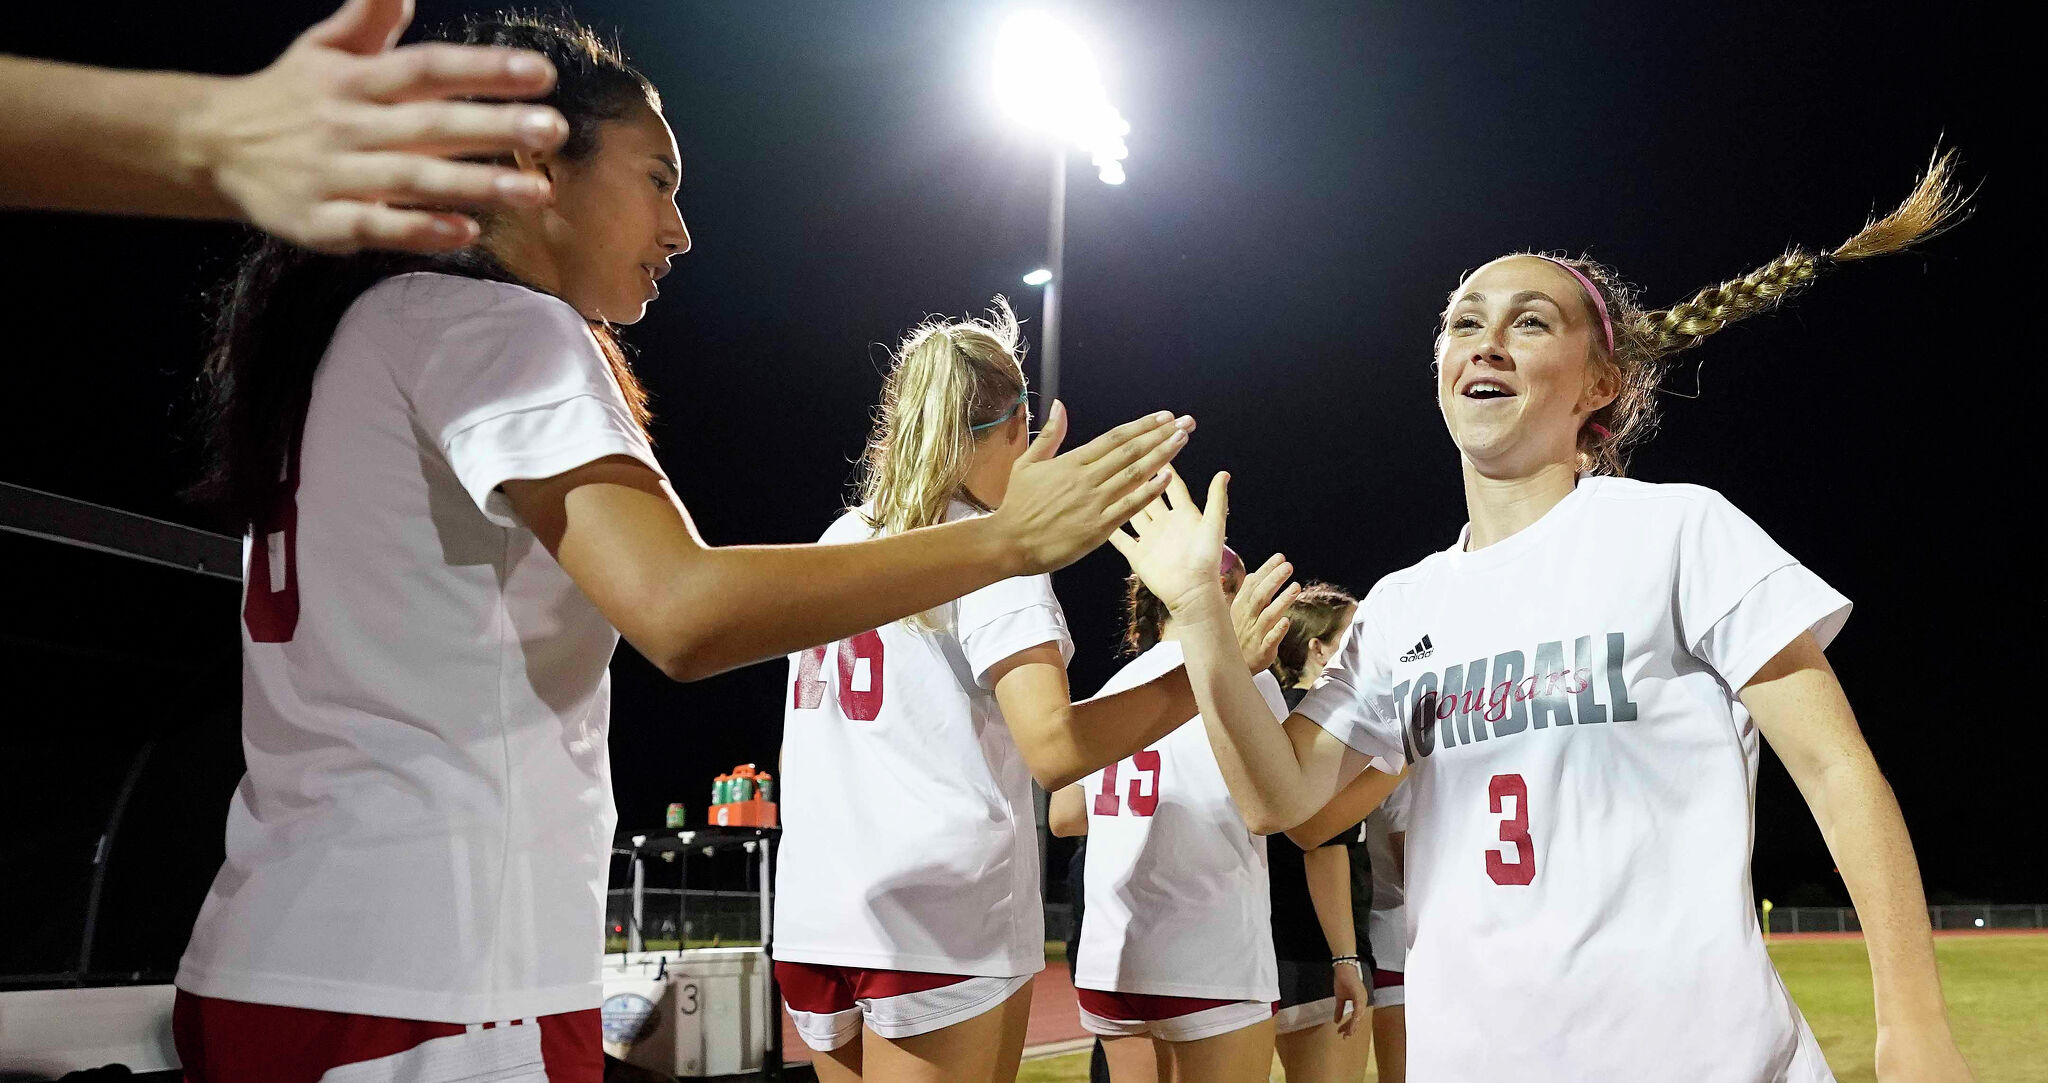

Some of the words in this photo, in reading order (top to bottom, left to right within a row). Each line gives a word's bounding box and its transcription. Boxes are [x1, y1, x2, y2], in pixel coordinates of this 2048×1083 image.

[1393, 632, 1638, 766] TOMBALL
[1412, 667, 1589, 731] Cougars
[1094, 750, 1161, 817] 15
[1485, 774, 1536, 886] 3
[681, 983, 698, 1015] 3
